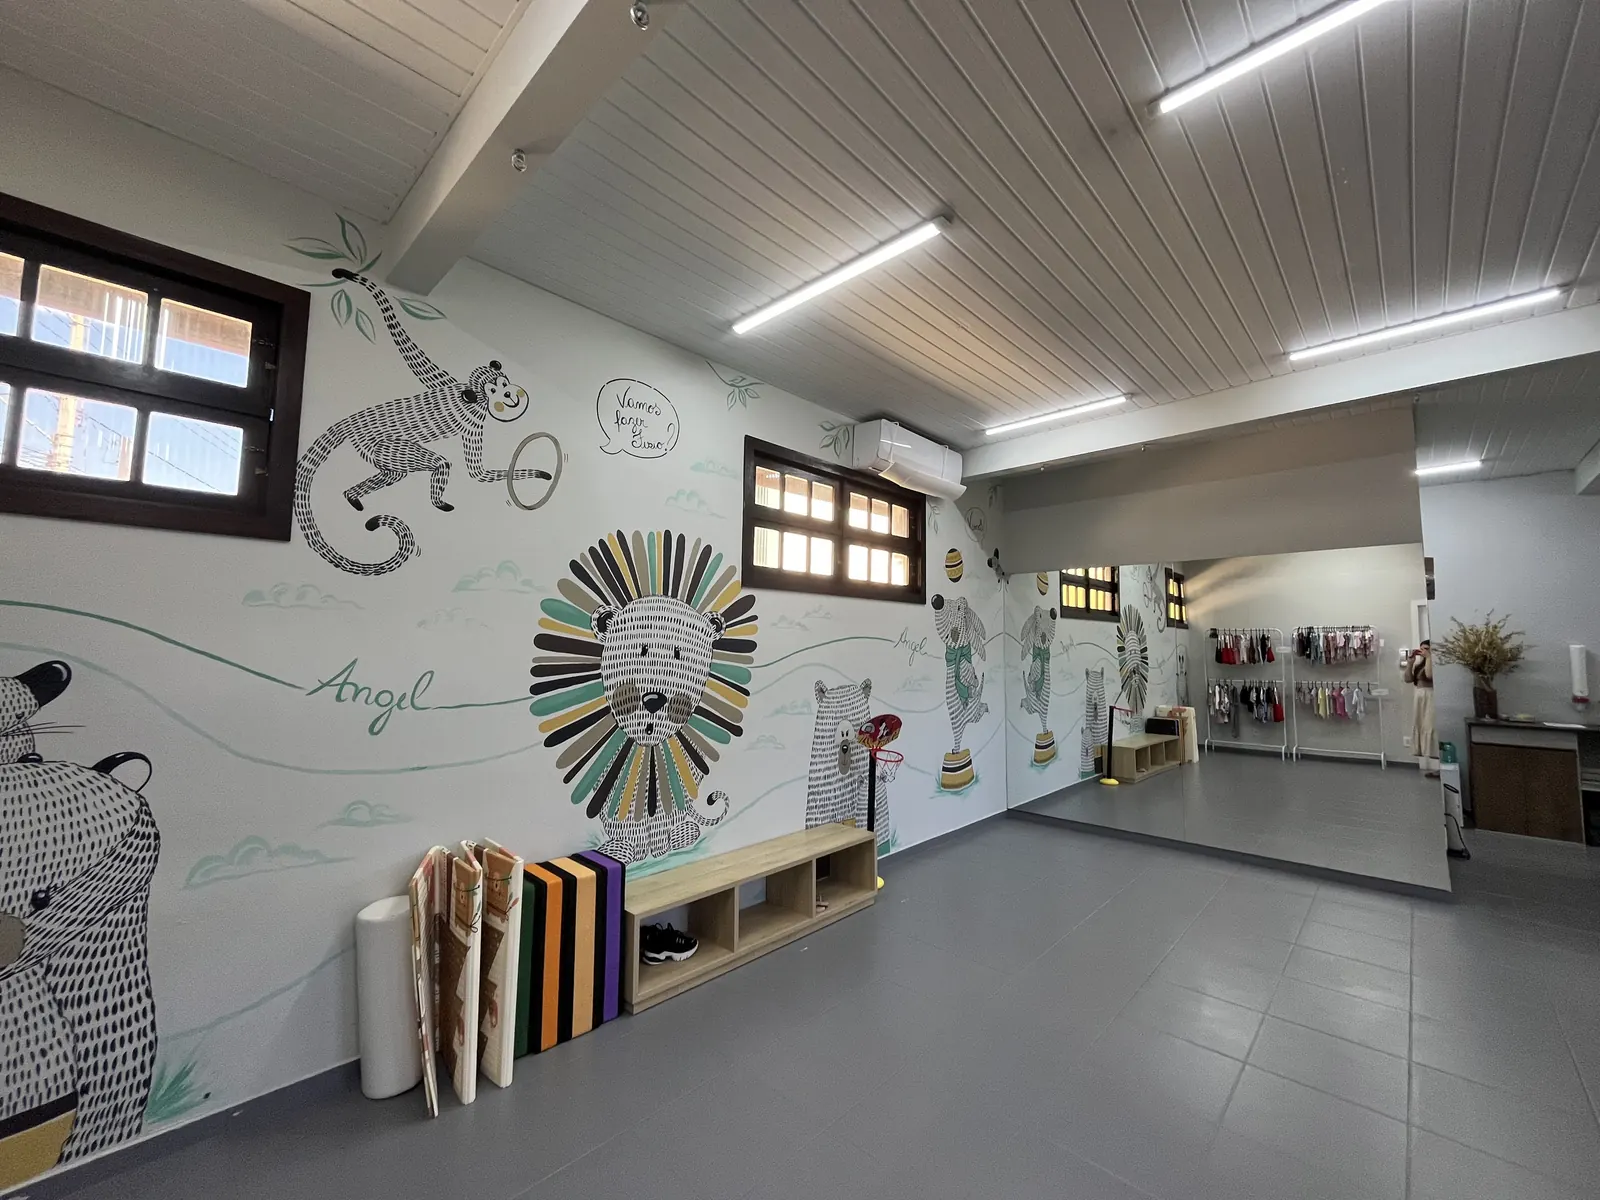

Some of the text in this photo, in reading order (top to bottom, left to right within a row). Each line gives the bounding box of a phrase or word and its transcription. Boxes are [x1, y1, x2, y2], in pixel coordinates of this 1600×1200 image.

[616, 386, 661, 416] Vamos
[614, 409, 648, 433] fazer
[893, 626, 928, 667] Angel
[305, 657, 435, 736] Angel
